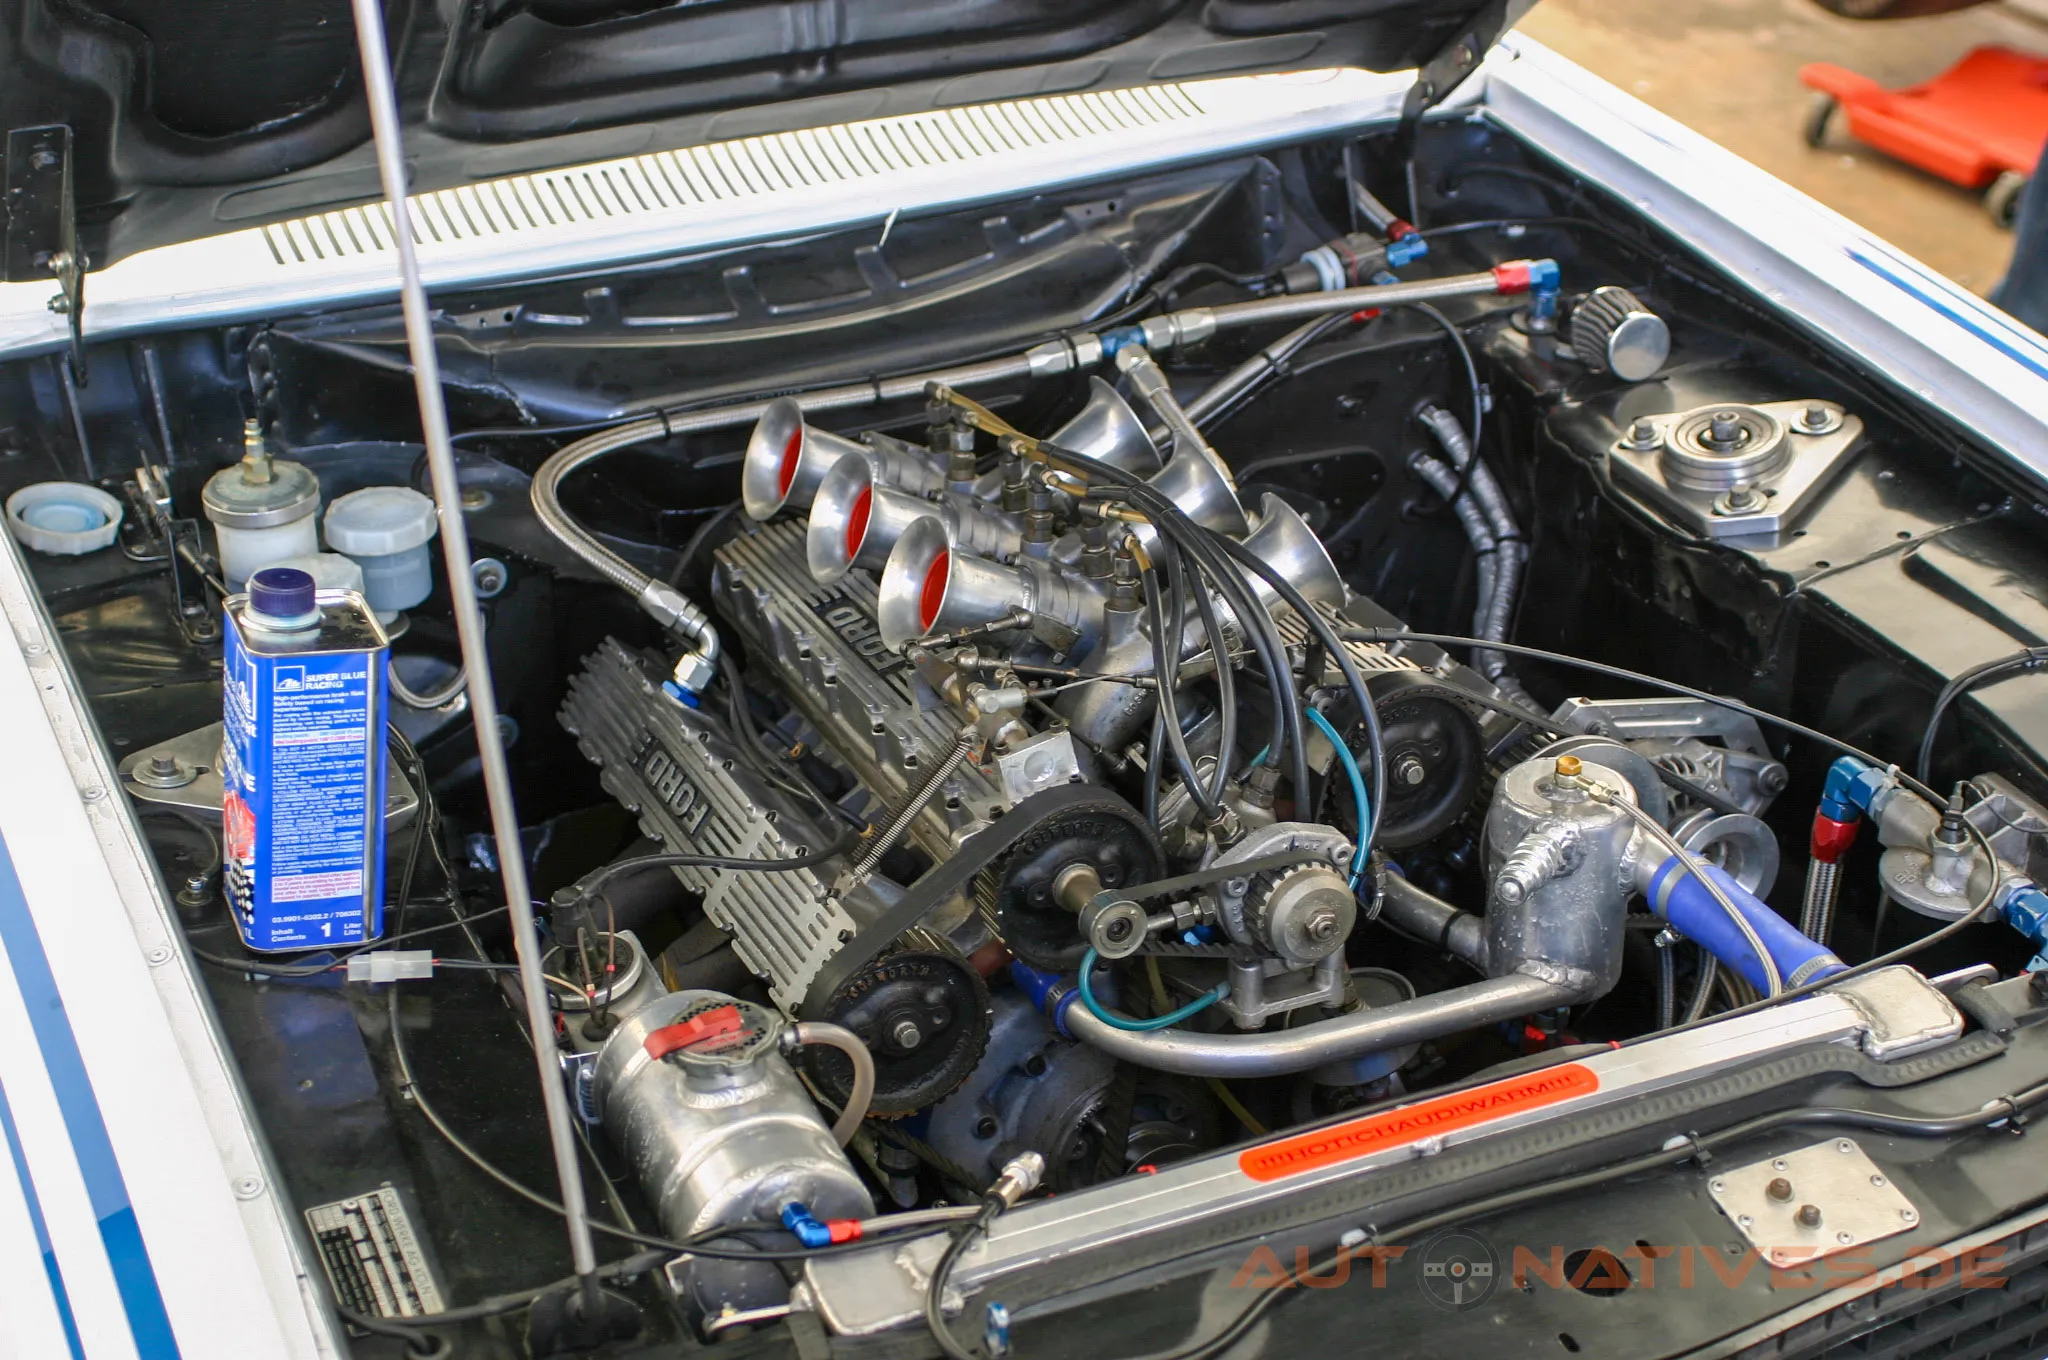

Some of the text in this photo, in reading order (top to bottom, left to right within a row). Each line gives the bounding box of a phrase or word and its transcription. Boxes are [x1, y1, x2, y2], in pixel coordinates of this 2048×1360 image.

[824, 606, 907, 671] FORD
[304, 671, 366, 681] SUPER BLUE
[304, 681, 344, 690] RACING
[644, 750, 709, 834] FORD
[320, 922, 331, 937] 1
[271, 934, 307, 942] Contents
